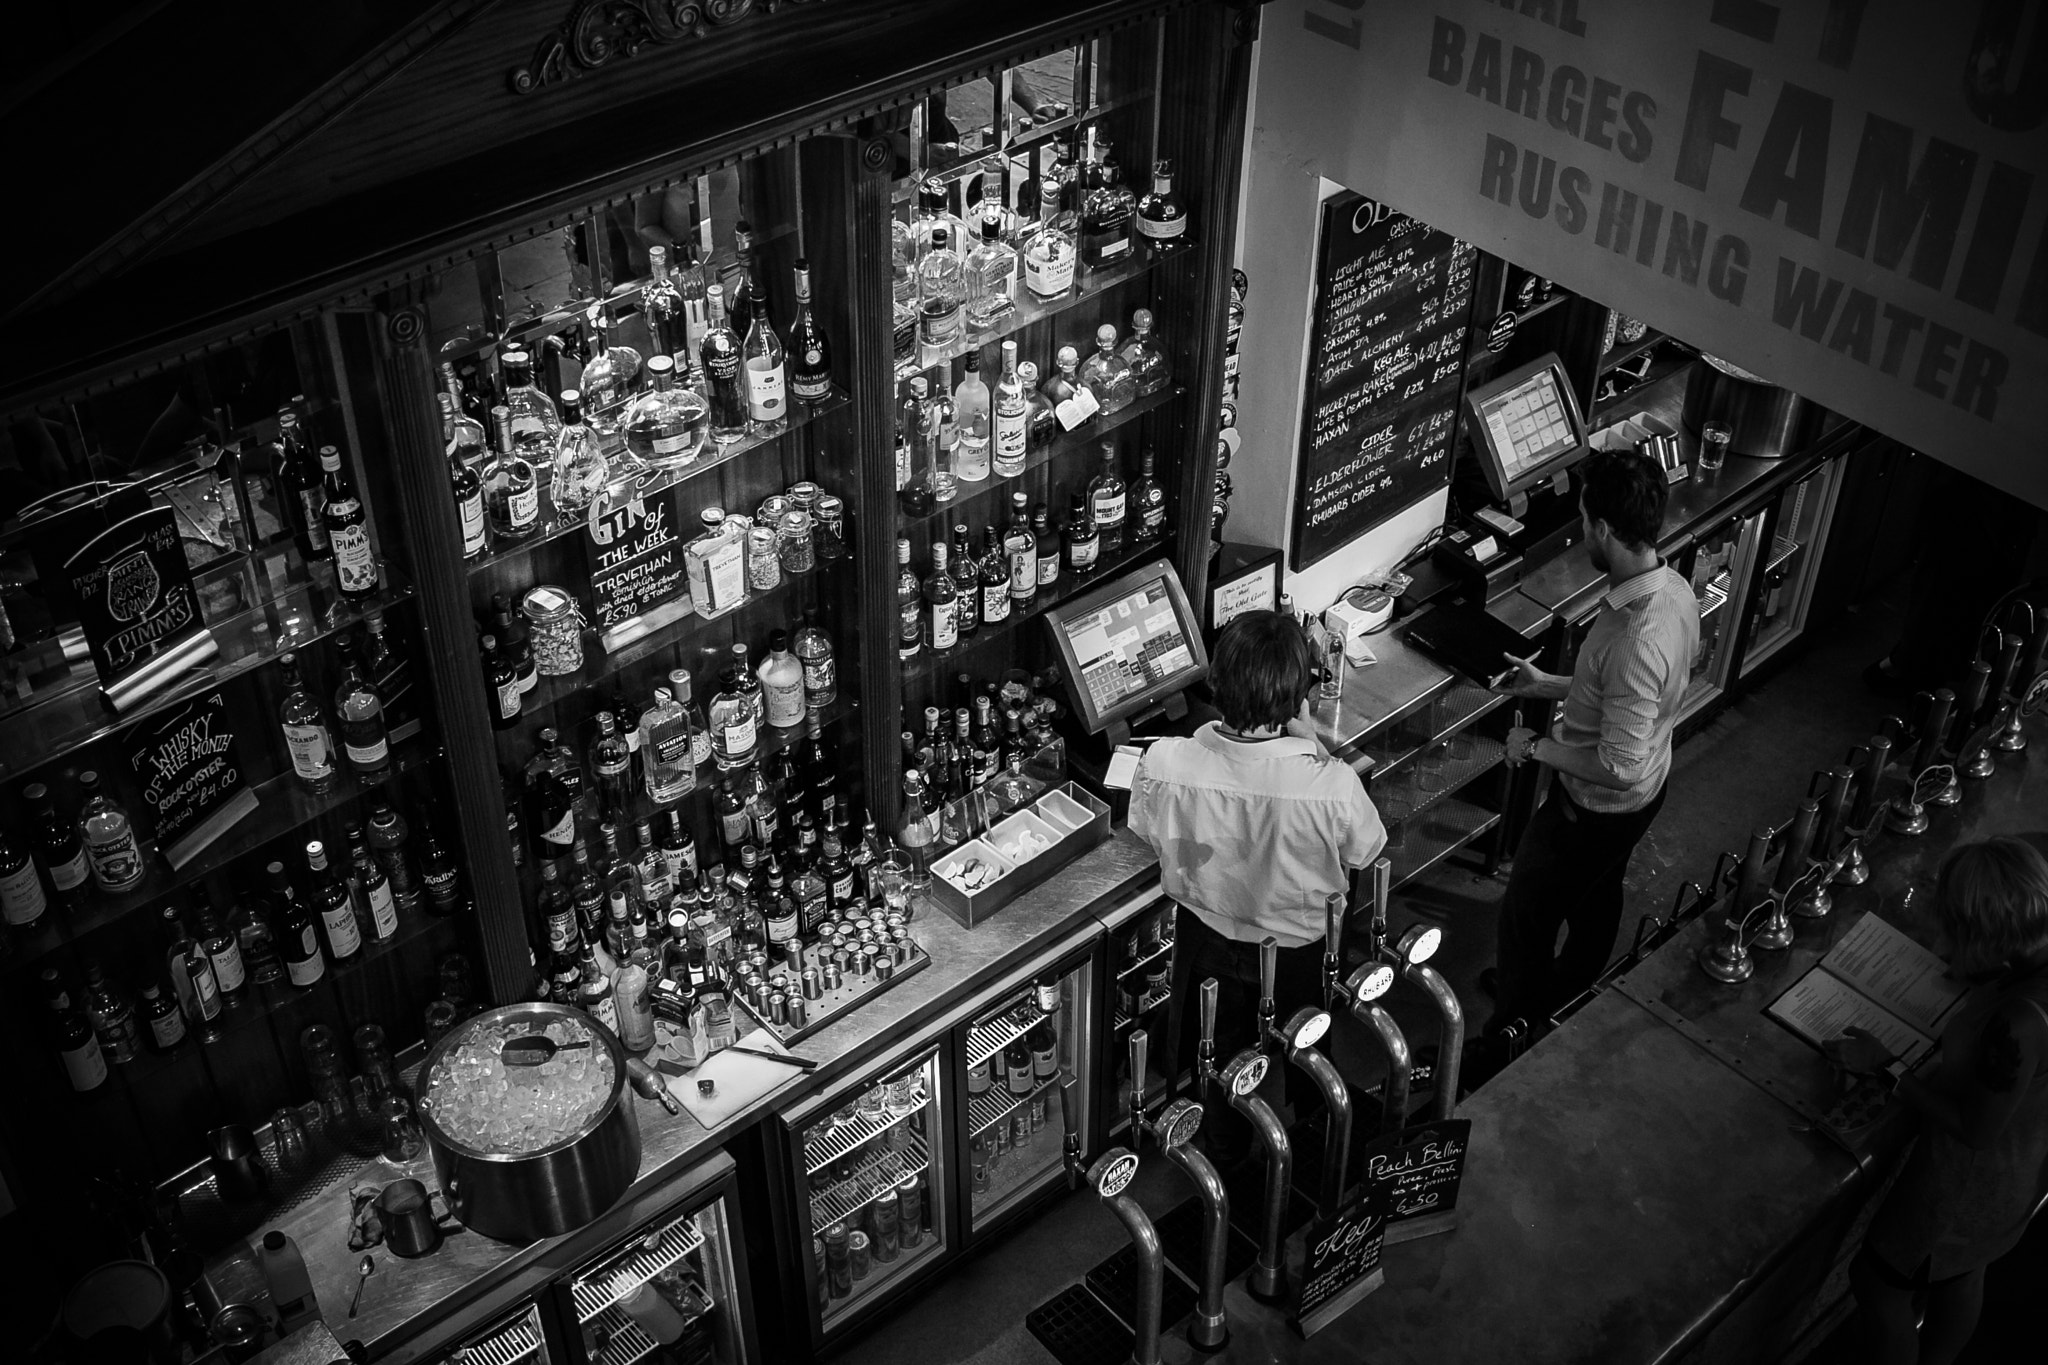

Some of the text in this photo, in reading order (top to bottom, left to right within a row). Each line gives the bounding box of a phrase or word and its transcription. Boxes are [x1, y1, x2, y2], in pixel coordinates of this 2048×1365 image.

[1427, 15, 1658, 164] BARGES
[1332, 276, 1355, 297] PRIDE
[1364, 257, 1393, 279] PENDLE
[1335, 245, 1386, 281] LIGHT ALE
[1478, 132, 2010, 422] RUSHING WATER
[1331, 288, 1357, 310] HEART
[1368, 274, 1387, 290] SOUL
[1334, 281, 1394, 320] SINGULARITY
[1325, 326, 1361, 352] CASCADE
[1331, 313, 1361, 335] CITRA
[1325, 359, 1354, 384] DARK
[1360, 331, 1404, 362] ALCHEMY
[1327, 347, 1351, 366] ATOM
[1373, 352, 1393, 373] KEG
[1394, 343, 1411, 361] ALE
[1317, 418, 1335, 432] LIFE
[1346, 395, 1373, 415] DEATH
[1318, 393, 1350, 418] HICKEY
[1315, 419, 1351, 449] HAXAN
[1361, 425, 1394, 450] CIDER
[1313, 481, 1353, 509] DAMSON
[1357, 465, 1386, 485] CIDER
[1314, 443, 1394, 493] ELDERFLOWER
[589, 491, 646, 545] GIN
[1311, 498, 1348, 527] RHUBARB
[1351, 483, 1376, 504] CIDER
[598, 527, 668, 566] THE WEEK
[595, 551, 672, 594] TREVETHAN
[117, 603, 187, 654] PIMM'S
[149, 712, 213, 772] WHISKY
[658, 733, 687, 750] AVIATION
[144, 733, 234, 805] OF THE MONTH
[158, 756, 227, 815] ROCK OYSTER
[1107, 1159, 1130, 1185] HAXAN
[1368, 1140, 1464, 1179] Peach Bellini
[1313, 1215, 1382, 1269] Keg
